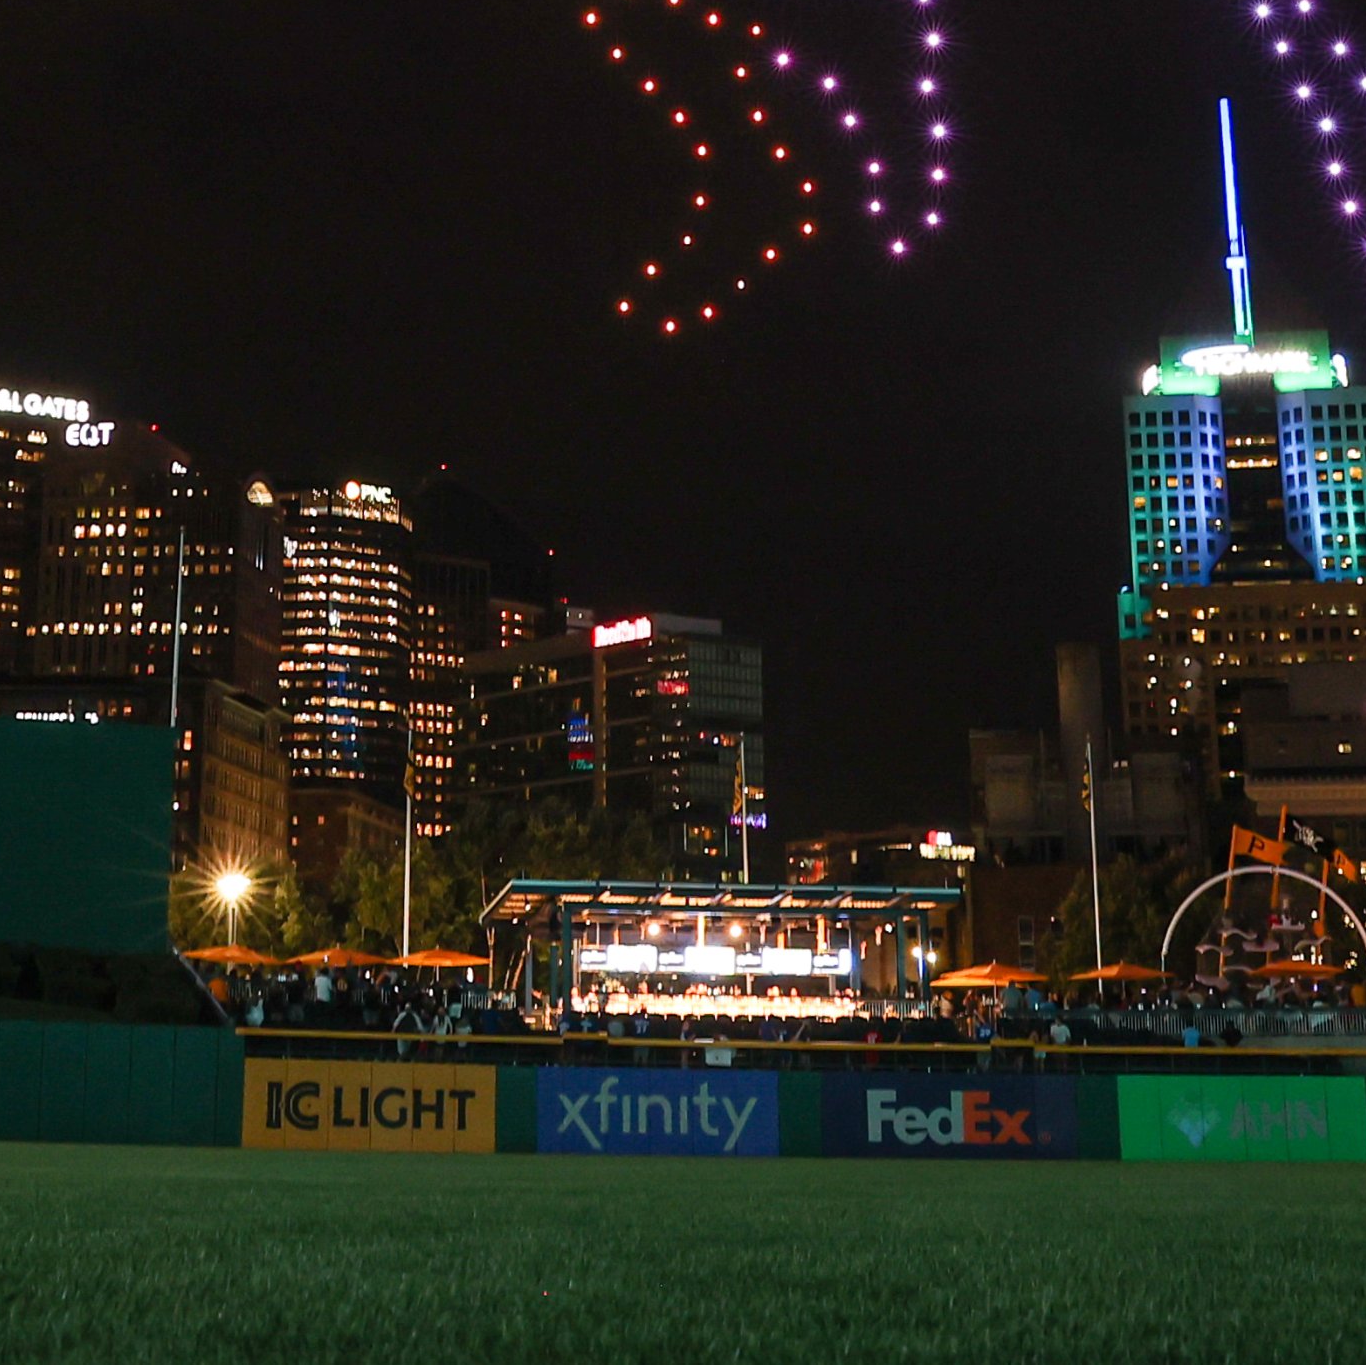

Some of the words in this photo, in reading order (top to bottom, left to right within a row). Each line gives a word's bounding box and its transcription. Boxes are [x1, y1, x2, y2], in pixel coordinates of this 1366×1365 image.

[23, 393, 90, 423] GATES
[360, 482, 392, 504] PNC
[266, 1081, 320, 1129] IC
[333, 1086, 476, 1131] LIGHT
[557, 1076, 758, 1151] xfinity
[866, 1089, 1033, 1146] FedEx
[1228, 1098, 1329, 1143] AHN
